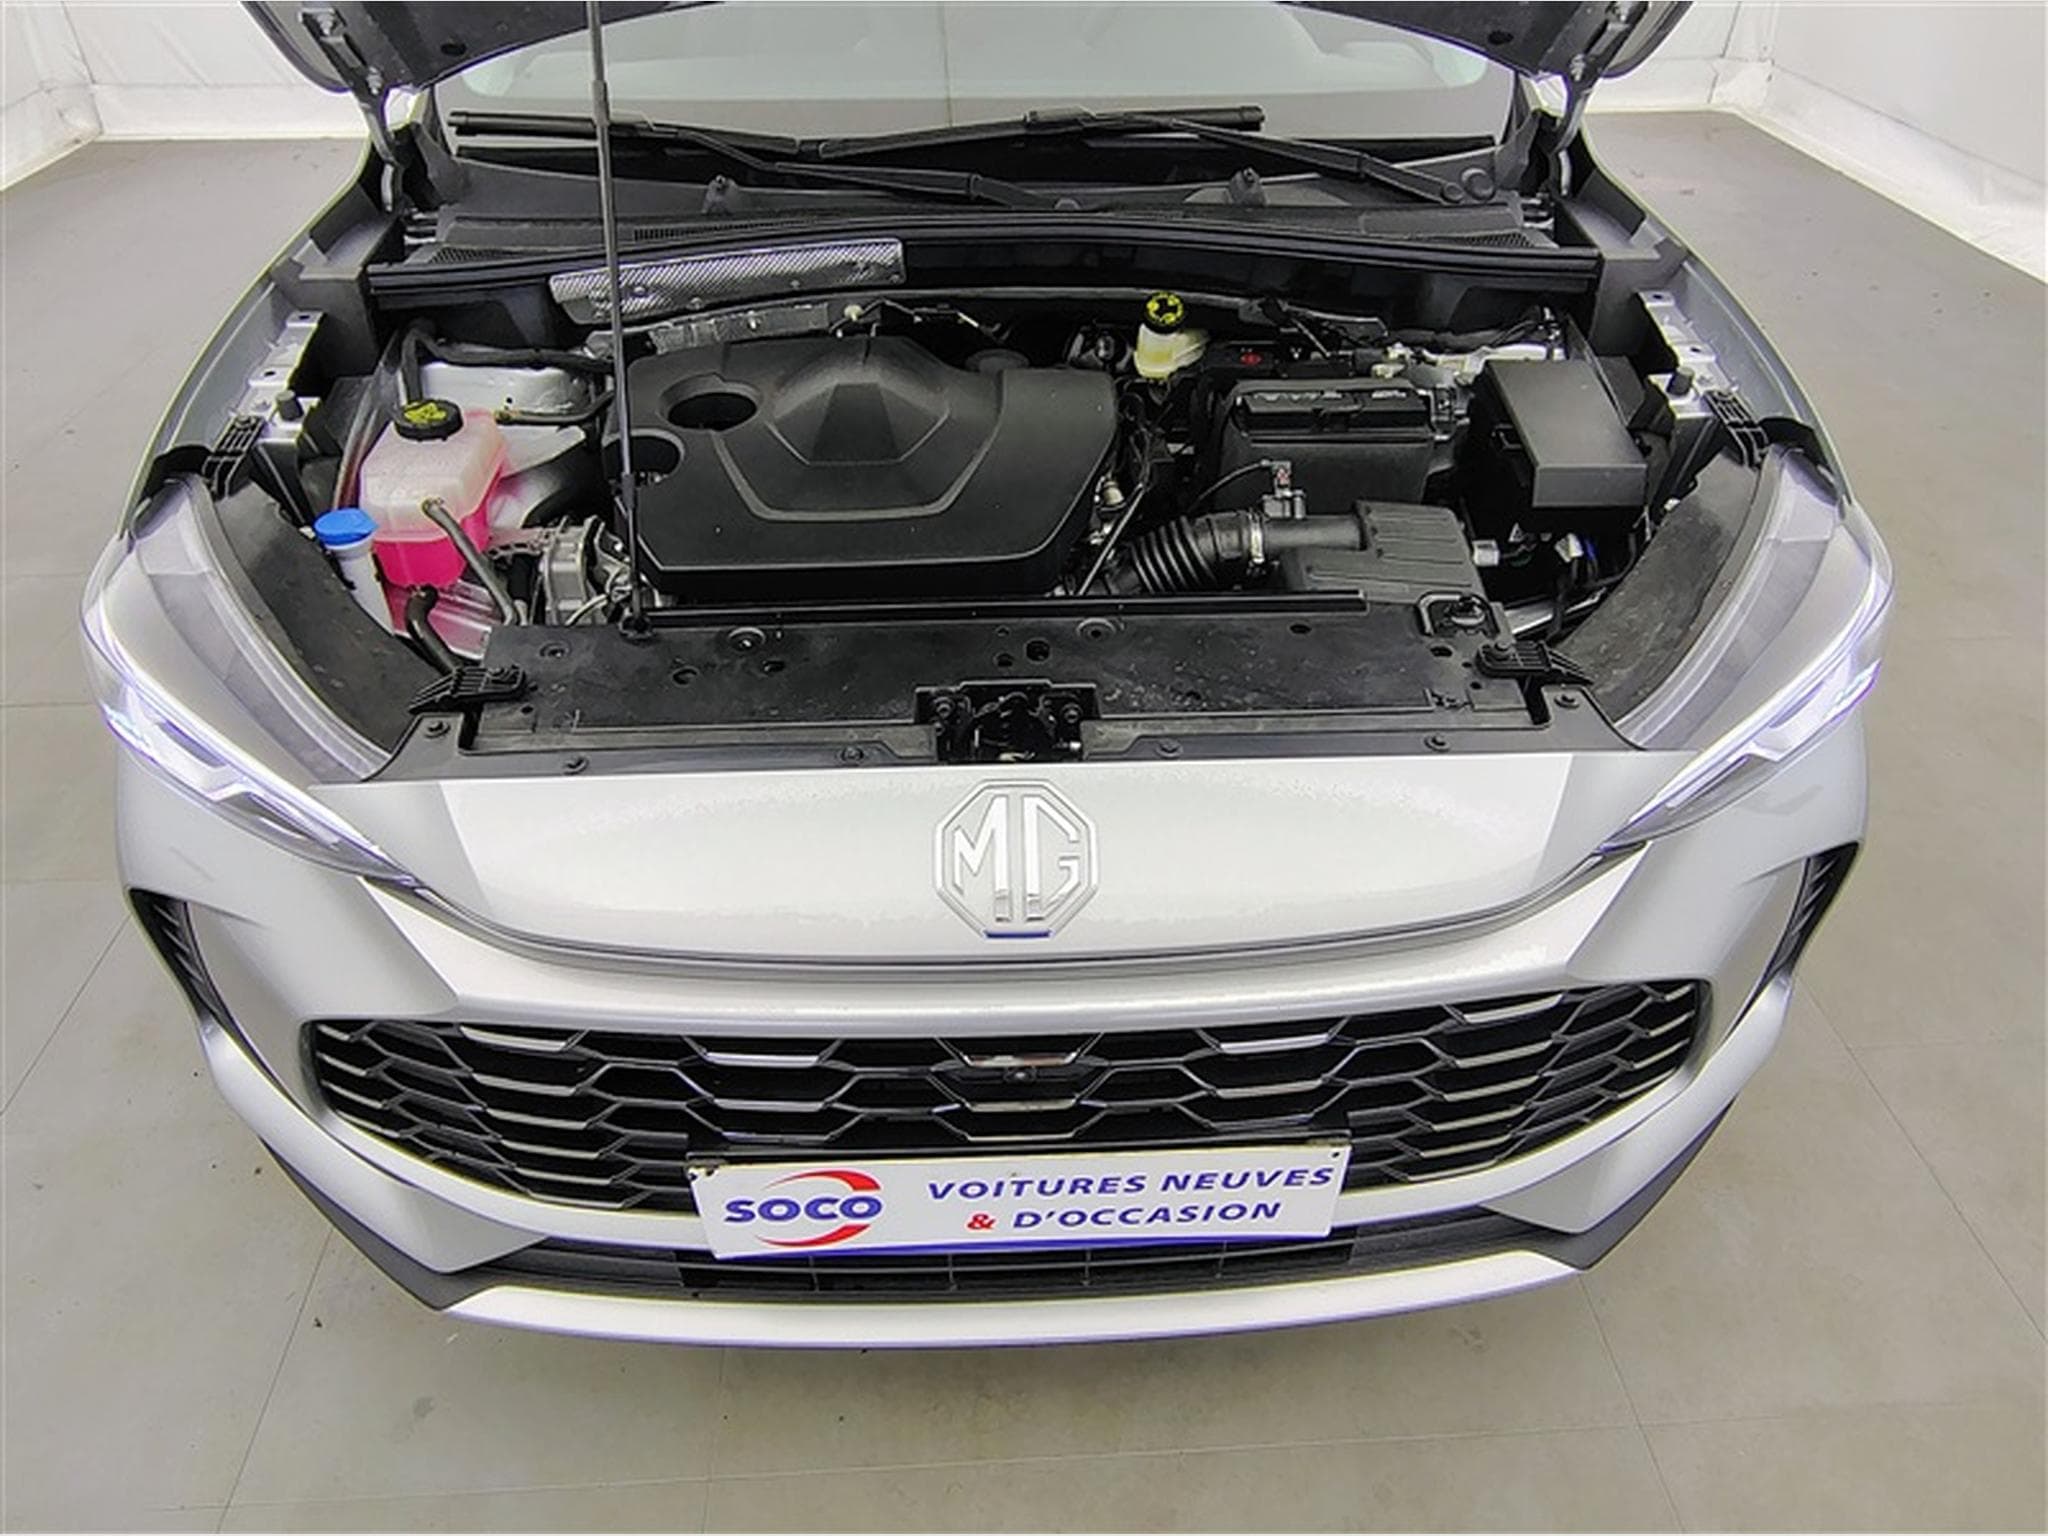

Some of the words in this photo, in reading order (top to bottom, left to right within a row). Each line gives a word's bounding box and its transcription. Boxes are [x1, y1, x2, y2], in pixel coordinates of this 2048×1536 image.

[952, 793, 1081, 923] MG
[928, 1176, 1146, 1199] VOITURES
[1161, 1168, 1334, 1192] NEUVES
[724, 1197, 883, 1223] SOCO
[966, 1213, 996, 1230] &
[1013, 1202, 1282, 1228] D'OCCASION
